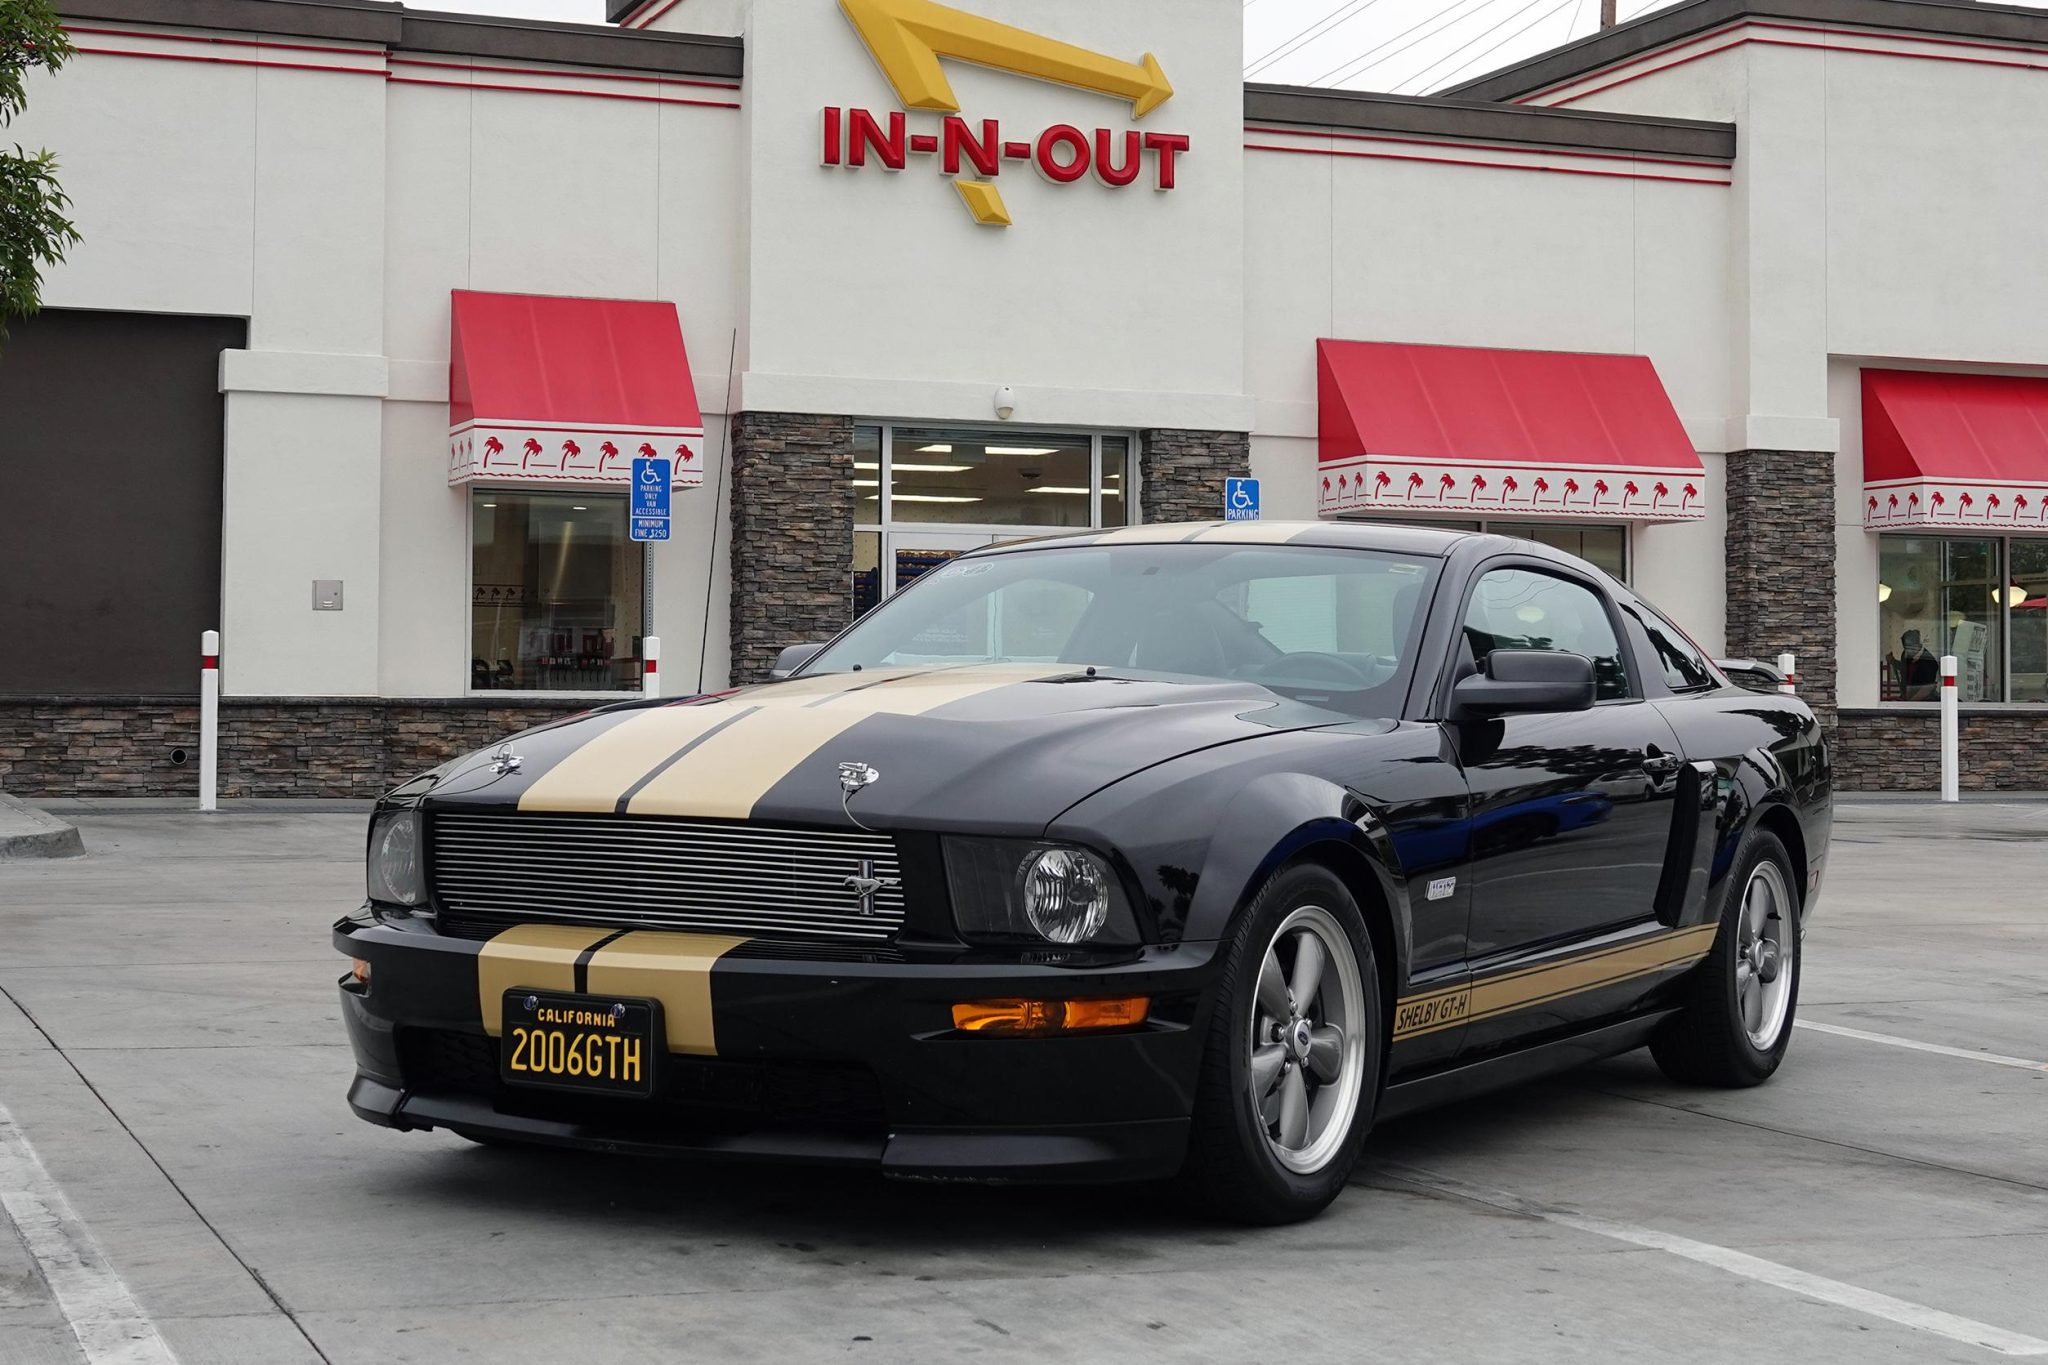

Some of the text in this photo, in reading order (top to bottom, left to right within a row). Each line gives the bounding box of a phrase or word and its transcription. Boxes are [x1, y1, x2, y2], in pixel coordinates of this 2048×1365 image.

[821, 106, 1190, 190] IN-N-OUT
[1228, 509, 1258, 520] PARKING
[635, 529, 666, 538] FINE $250
[538, 1008, 615, 1027] CALIFORNIA
[1397, 994, 1467, 1029] SHELBY GT-H
[511, 1028, 641, 1082] 2006GTH
